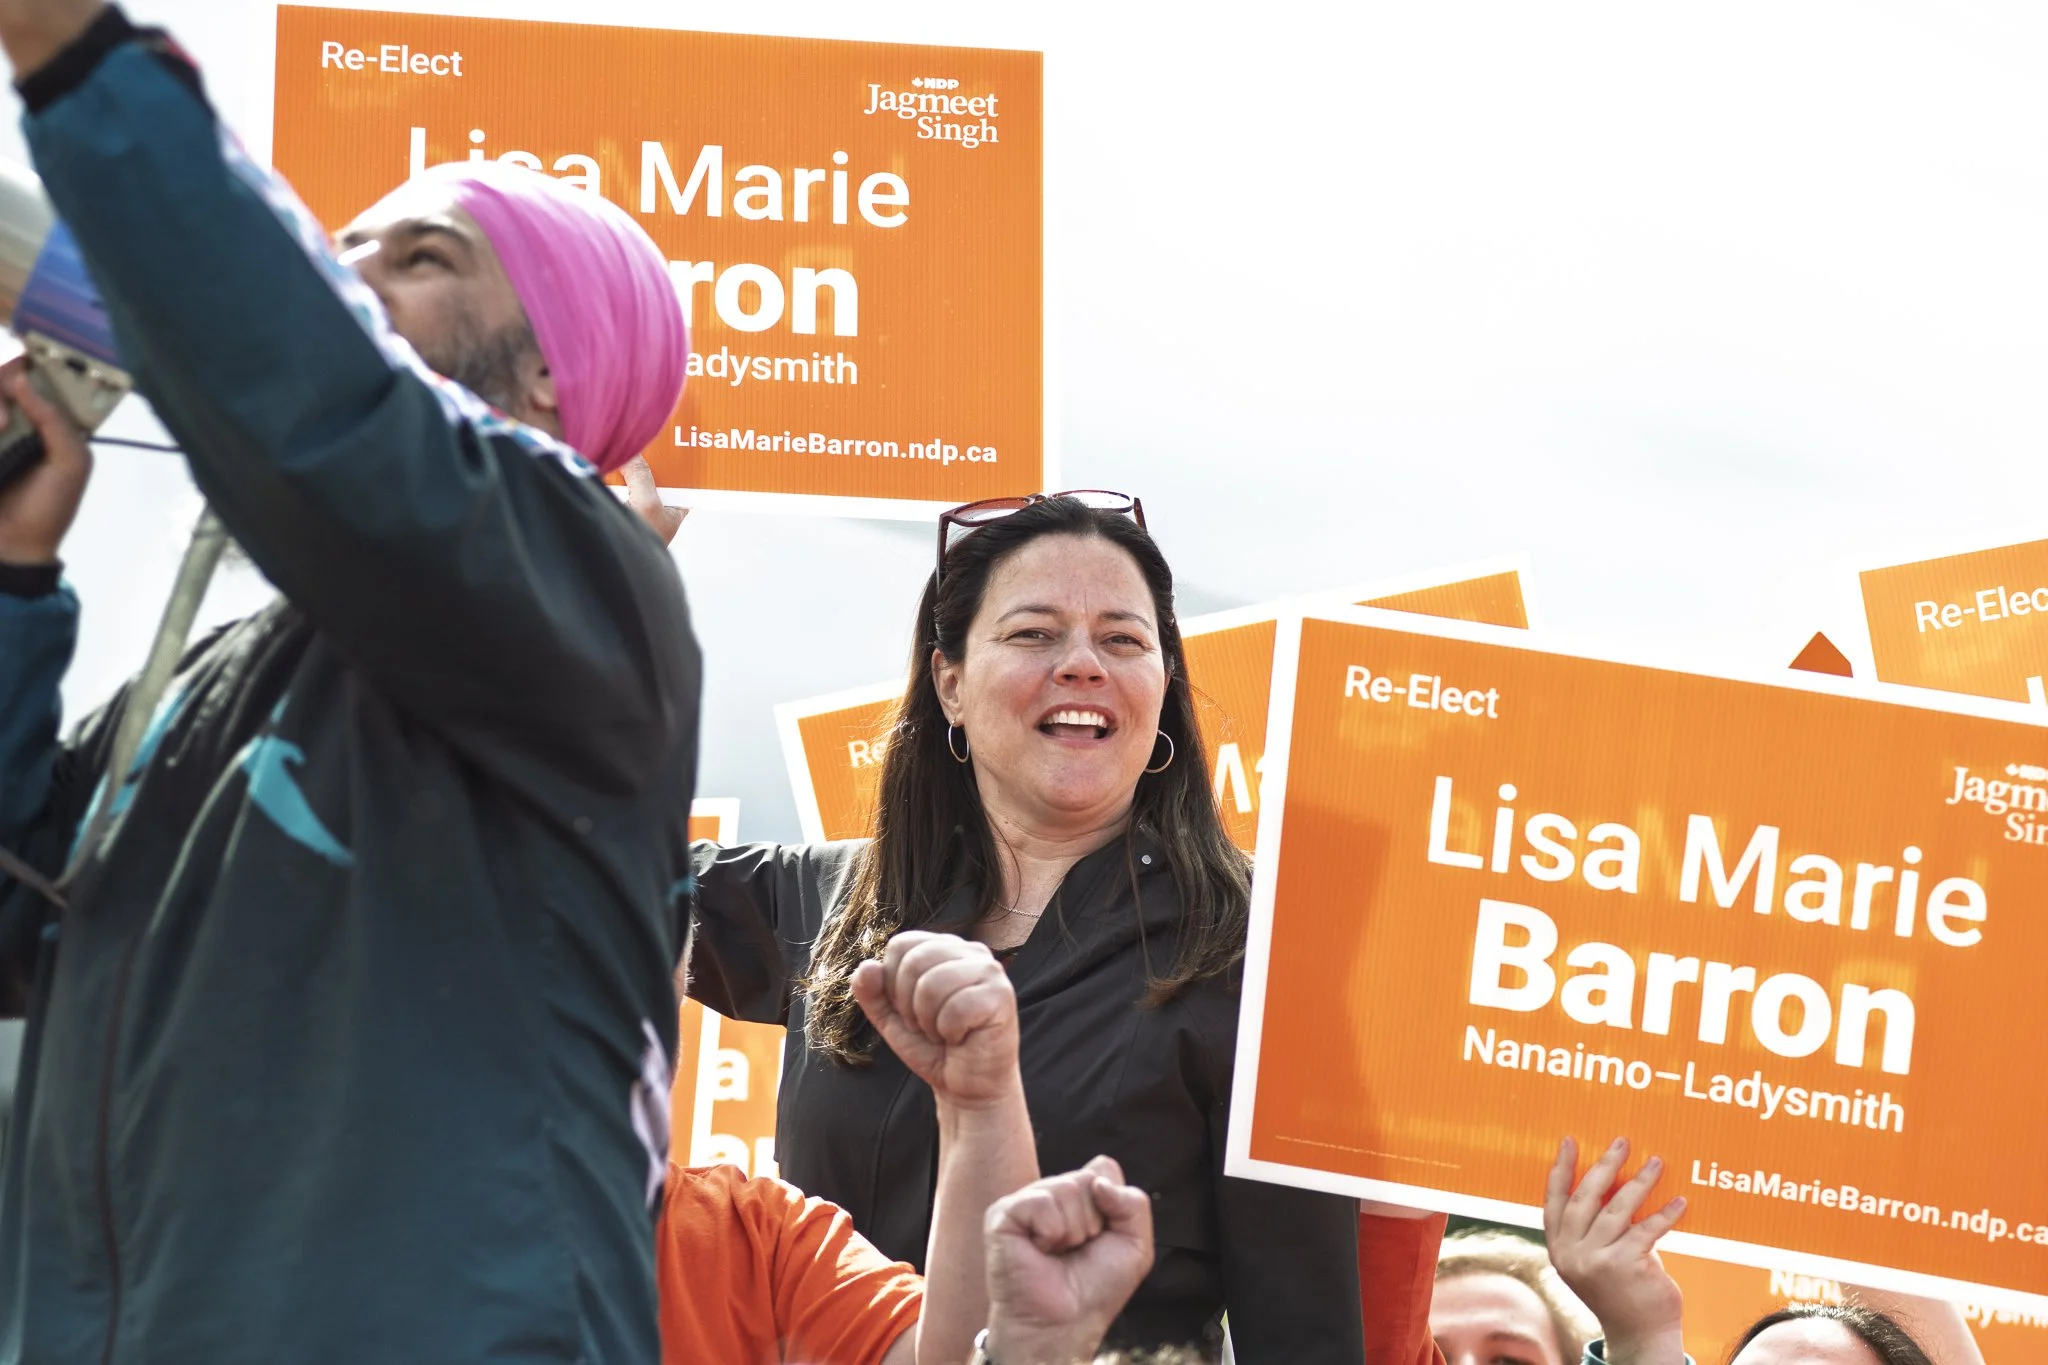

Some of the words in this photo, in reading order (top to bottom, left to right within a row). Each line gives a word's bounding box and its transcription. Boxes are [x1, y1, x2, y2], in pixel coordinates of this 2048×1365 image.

[320, 40, 464, 77] Re-Elect
[863, 83, 999, 119] Jagmeet
[923, 77, 960, 90] NDP
[916, 115, 999, 149] Singh
[639, 140, 910, 229] Marie
[668, 259, 859, 338] ron
[685, 344, 859, 388] adysmith
[673, 424, 998, 466] LisaMarieBarron.ndp.ca
[1913, 585, 2048, 633] Re-Elec
[1344, 664, 1500, 719] Re-Elect
[1945, 765, 2048, 815] Jagm
[1427, 775, 1642, 894] Lisa
[1679, 814, 1988, 948] Marie
[1469, 898, 1916, 1076] Barron
[1690, 1160, 2048, 1245] LisaMarieBarron.ndp.ca
